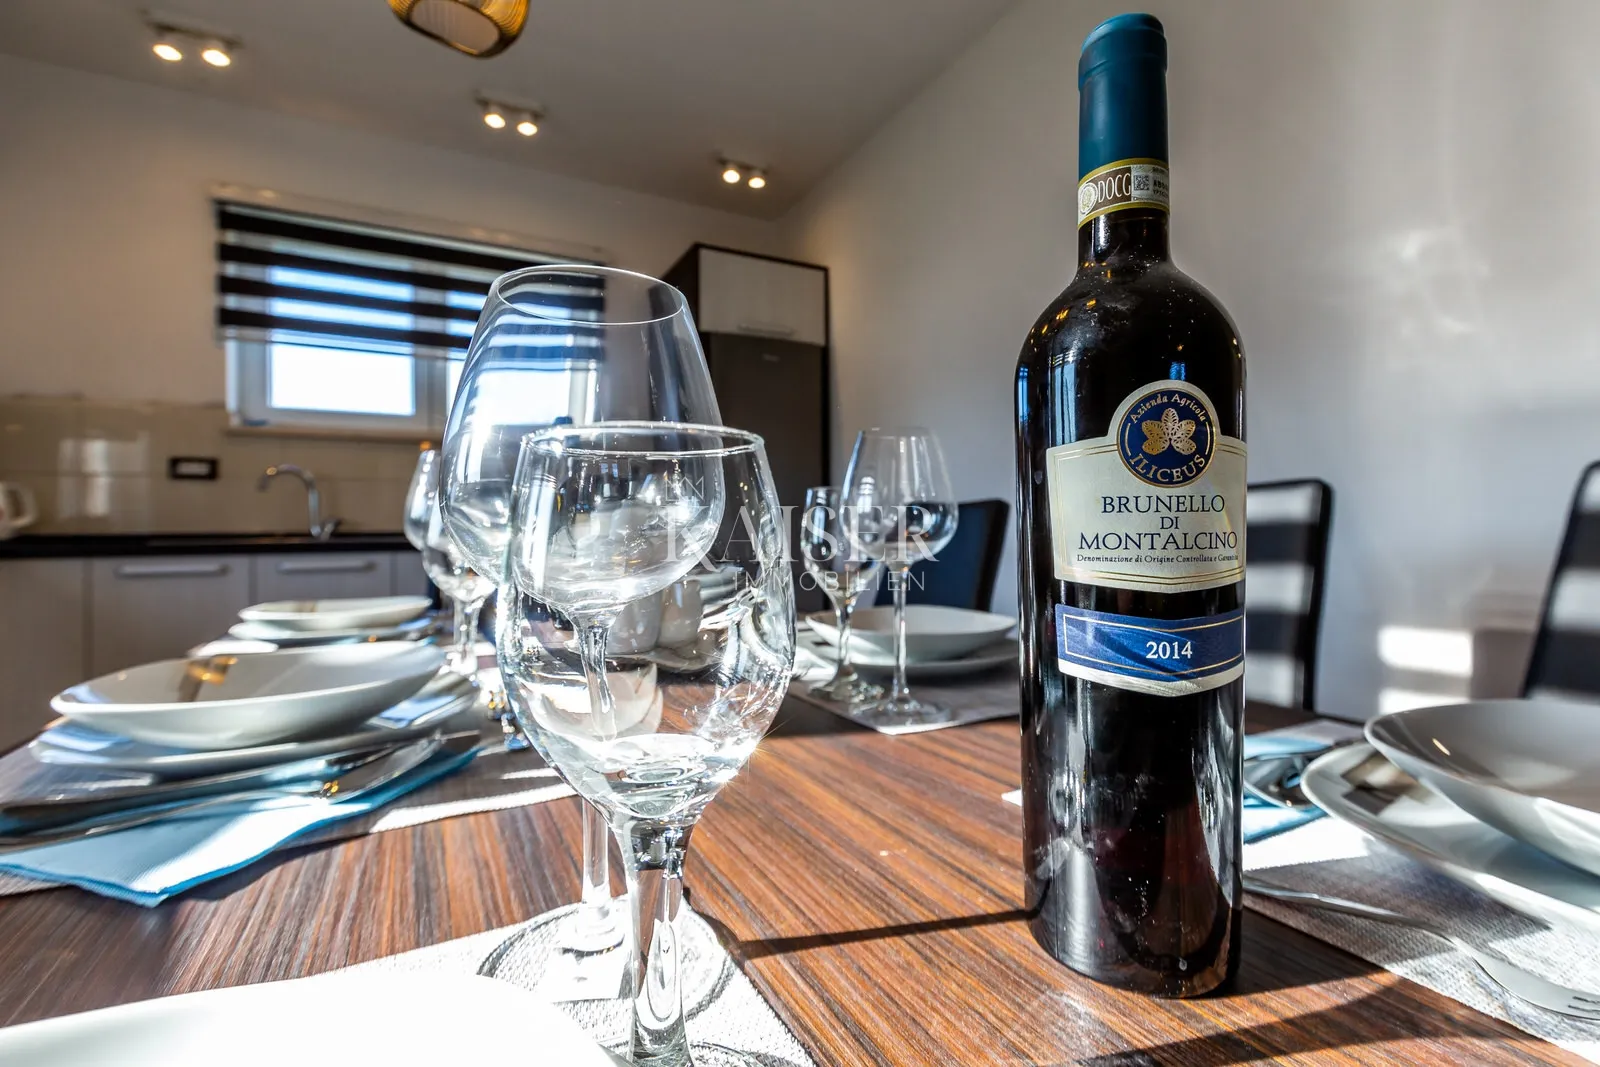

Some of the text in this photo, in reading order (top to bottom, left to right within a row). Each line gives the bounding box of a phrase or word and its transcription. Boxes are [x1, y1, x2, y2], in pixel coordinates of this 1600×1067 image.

[1097, 172, 1131, 203] DOCG
[1130, 393, 1207, 424] Azienda Agricola
[1129, 453, 1206, 482] ILICEUS
[1101, 494, 1225, 514] BRUNELLO
[1159, 516, 1180, 530] DI
[1078, 531, 1238, 551] MONTALCINO
[1077, 554, 1133, 563] Denominazione
[1134, 554, 1143, 563] di
[1144, 555, 1175, 566] Origine
[1175, 554, 1213, 563] Controllata
[1145, 641, 1193, 660] 2014
